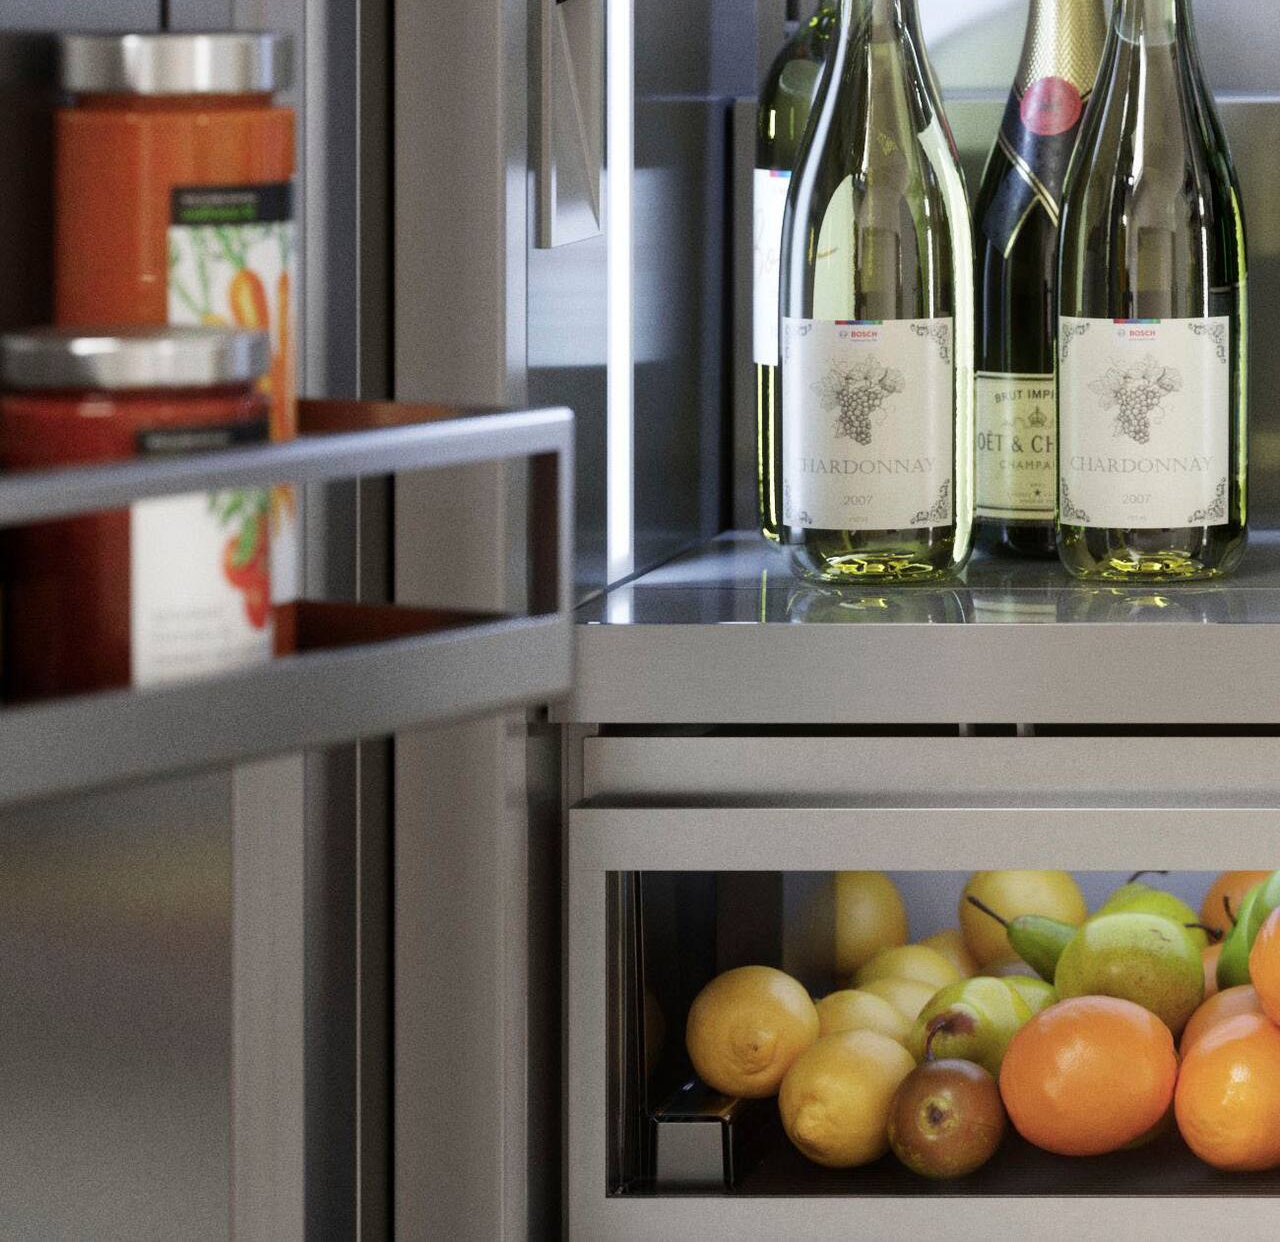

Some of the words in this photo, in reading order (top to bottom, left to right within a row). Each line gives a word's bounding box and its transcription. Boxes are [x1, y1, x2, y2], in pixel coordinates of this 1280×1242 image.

[994, 390, 1022, 403] BRUT
[1011, 435, 1024, 453] &
[797, 458, 937, 475] HARDONNAY
[1070, 456, 1214, 473] CHARDONNAY
[842, 495, 873, 506] 2007
[1121, 493, 1152, 504] 2007
